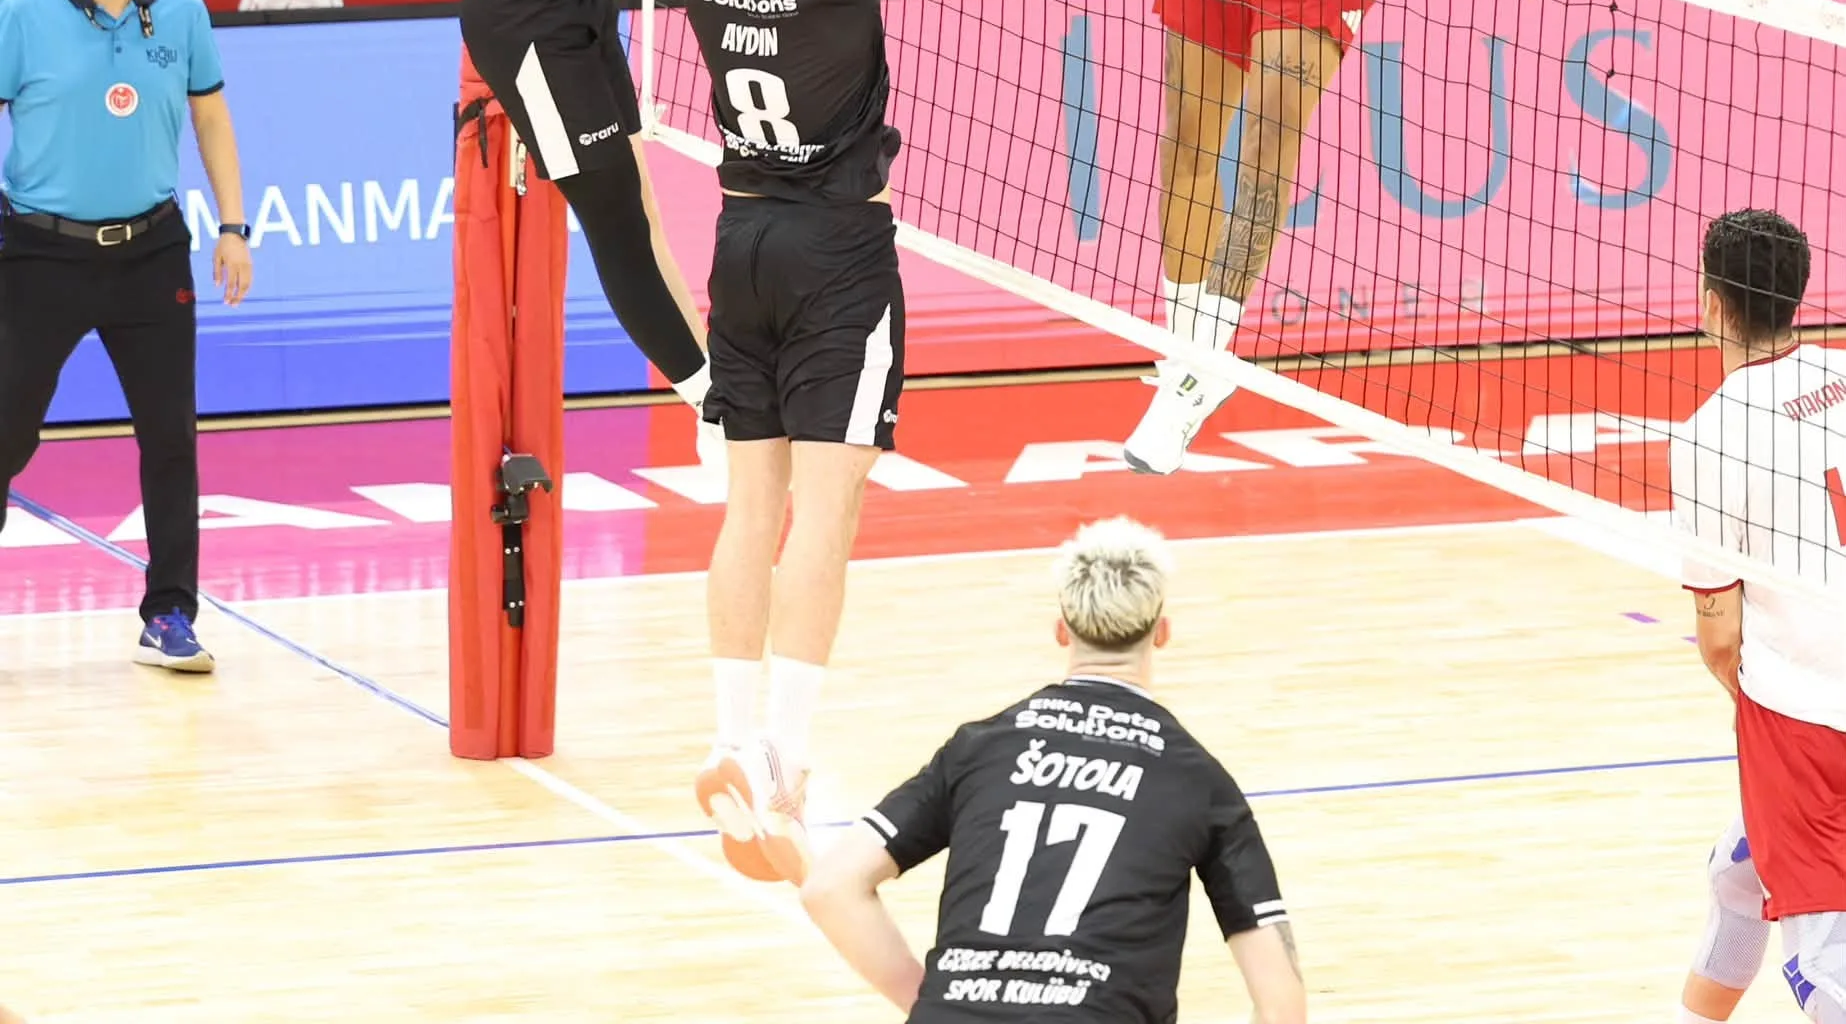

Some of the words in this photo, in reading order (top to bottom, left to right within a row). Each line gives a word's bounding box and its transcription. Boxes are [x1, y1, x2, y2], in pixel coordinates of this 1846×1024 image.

[721, 23, 779, 57] AYDIN
[725, 68, 800, 148] 8
[1015, 710, 1165, 751] Solutions
[1029, 698, 1084, 714] ENKA
[1088, 704, 1161, 733] Data
[1009, 739, 1144, 801] ŠOTOLA
[978, 800, 1127, 936] 17
[943, 978, 1002, 1002] SPOR
[1002, 977, 1091, 1005] KULÜBÜ
